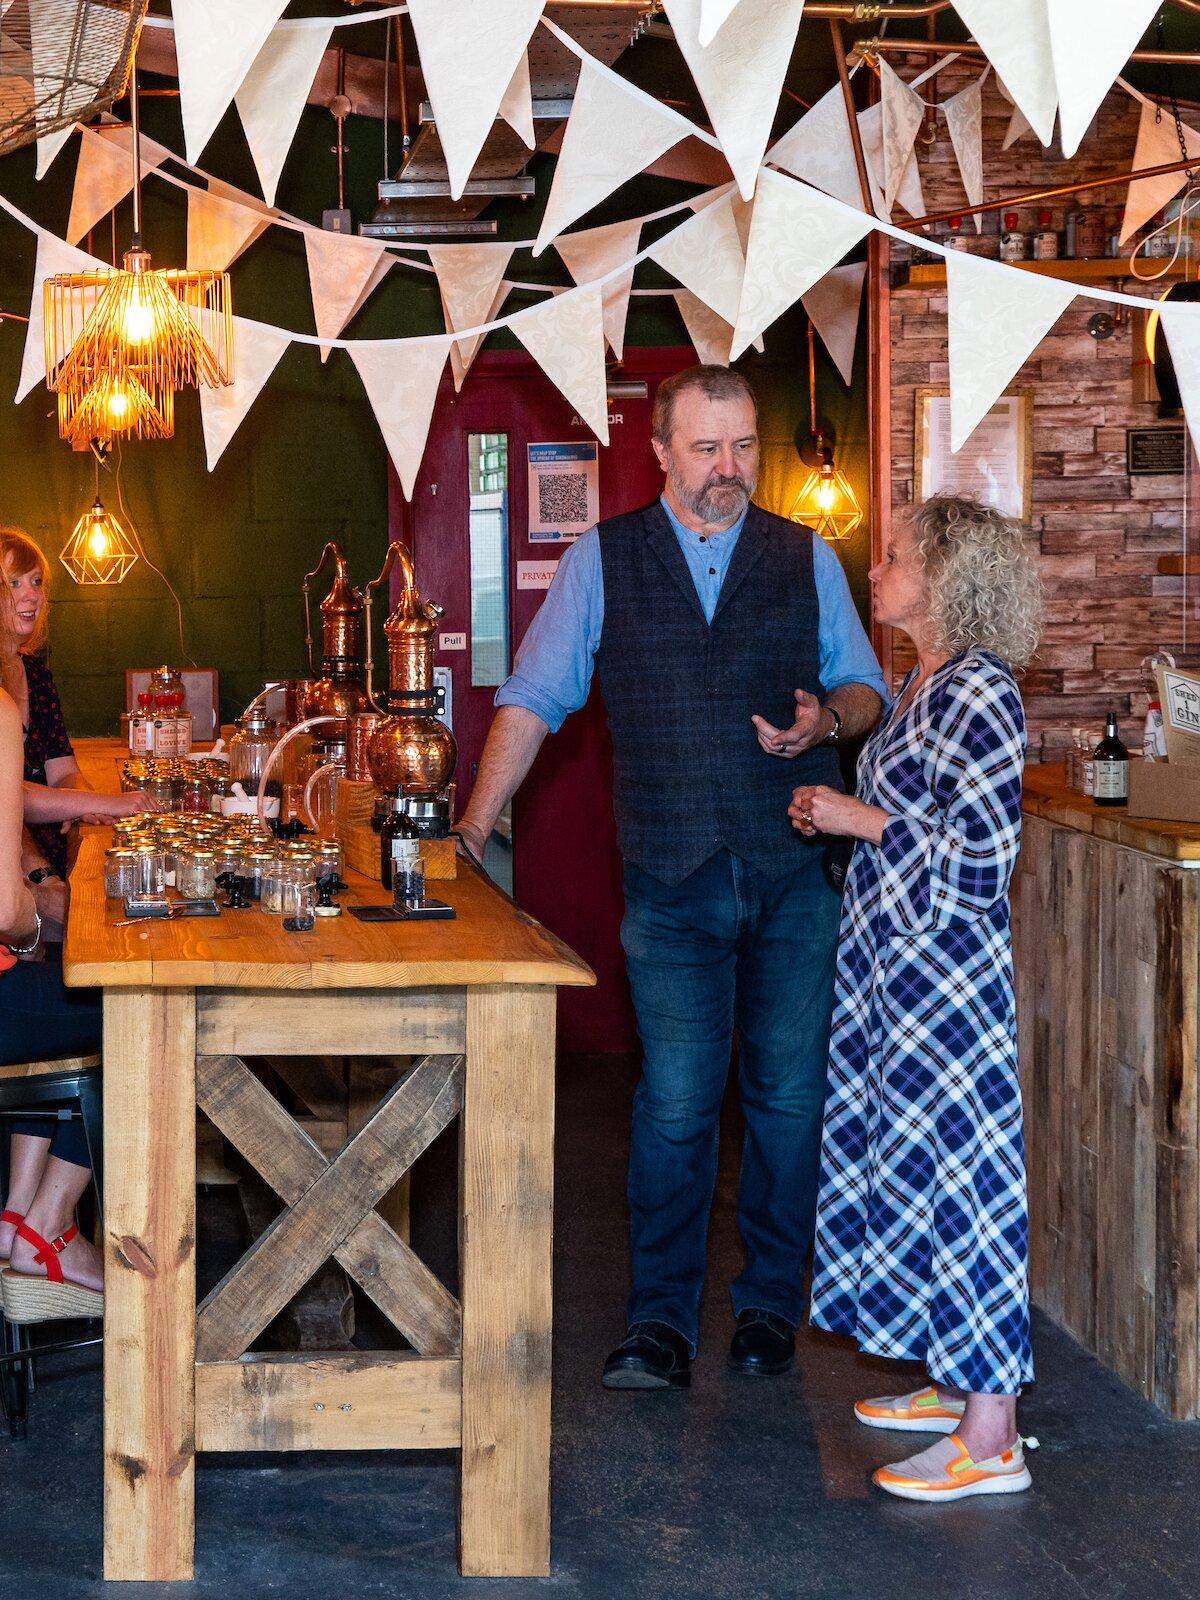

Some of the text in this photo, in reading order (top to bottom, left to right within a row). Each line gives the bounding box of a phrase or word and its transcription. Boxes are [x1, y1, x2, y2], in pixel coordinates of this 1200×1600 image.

[522, 571, 556, 581] PRIVAT
[444, 636, 462, 645] Pull
[1175, 689, 1198, 702] SHED
[1184, 700, 1189, 709] 1
[1177, 708, 1200, 724] GIN
